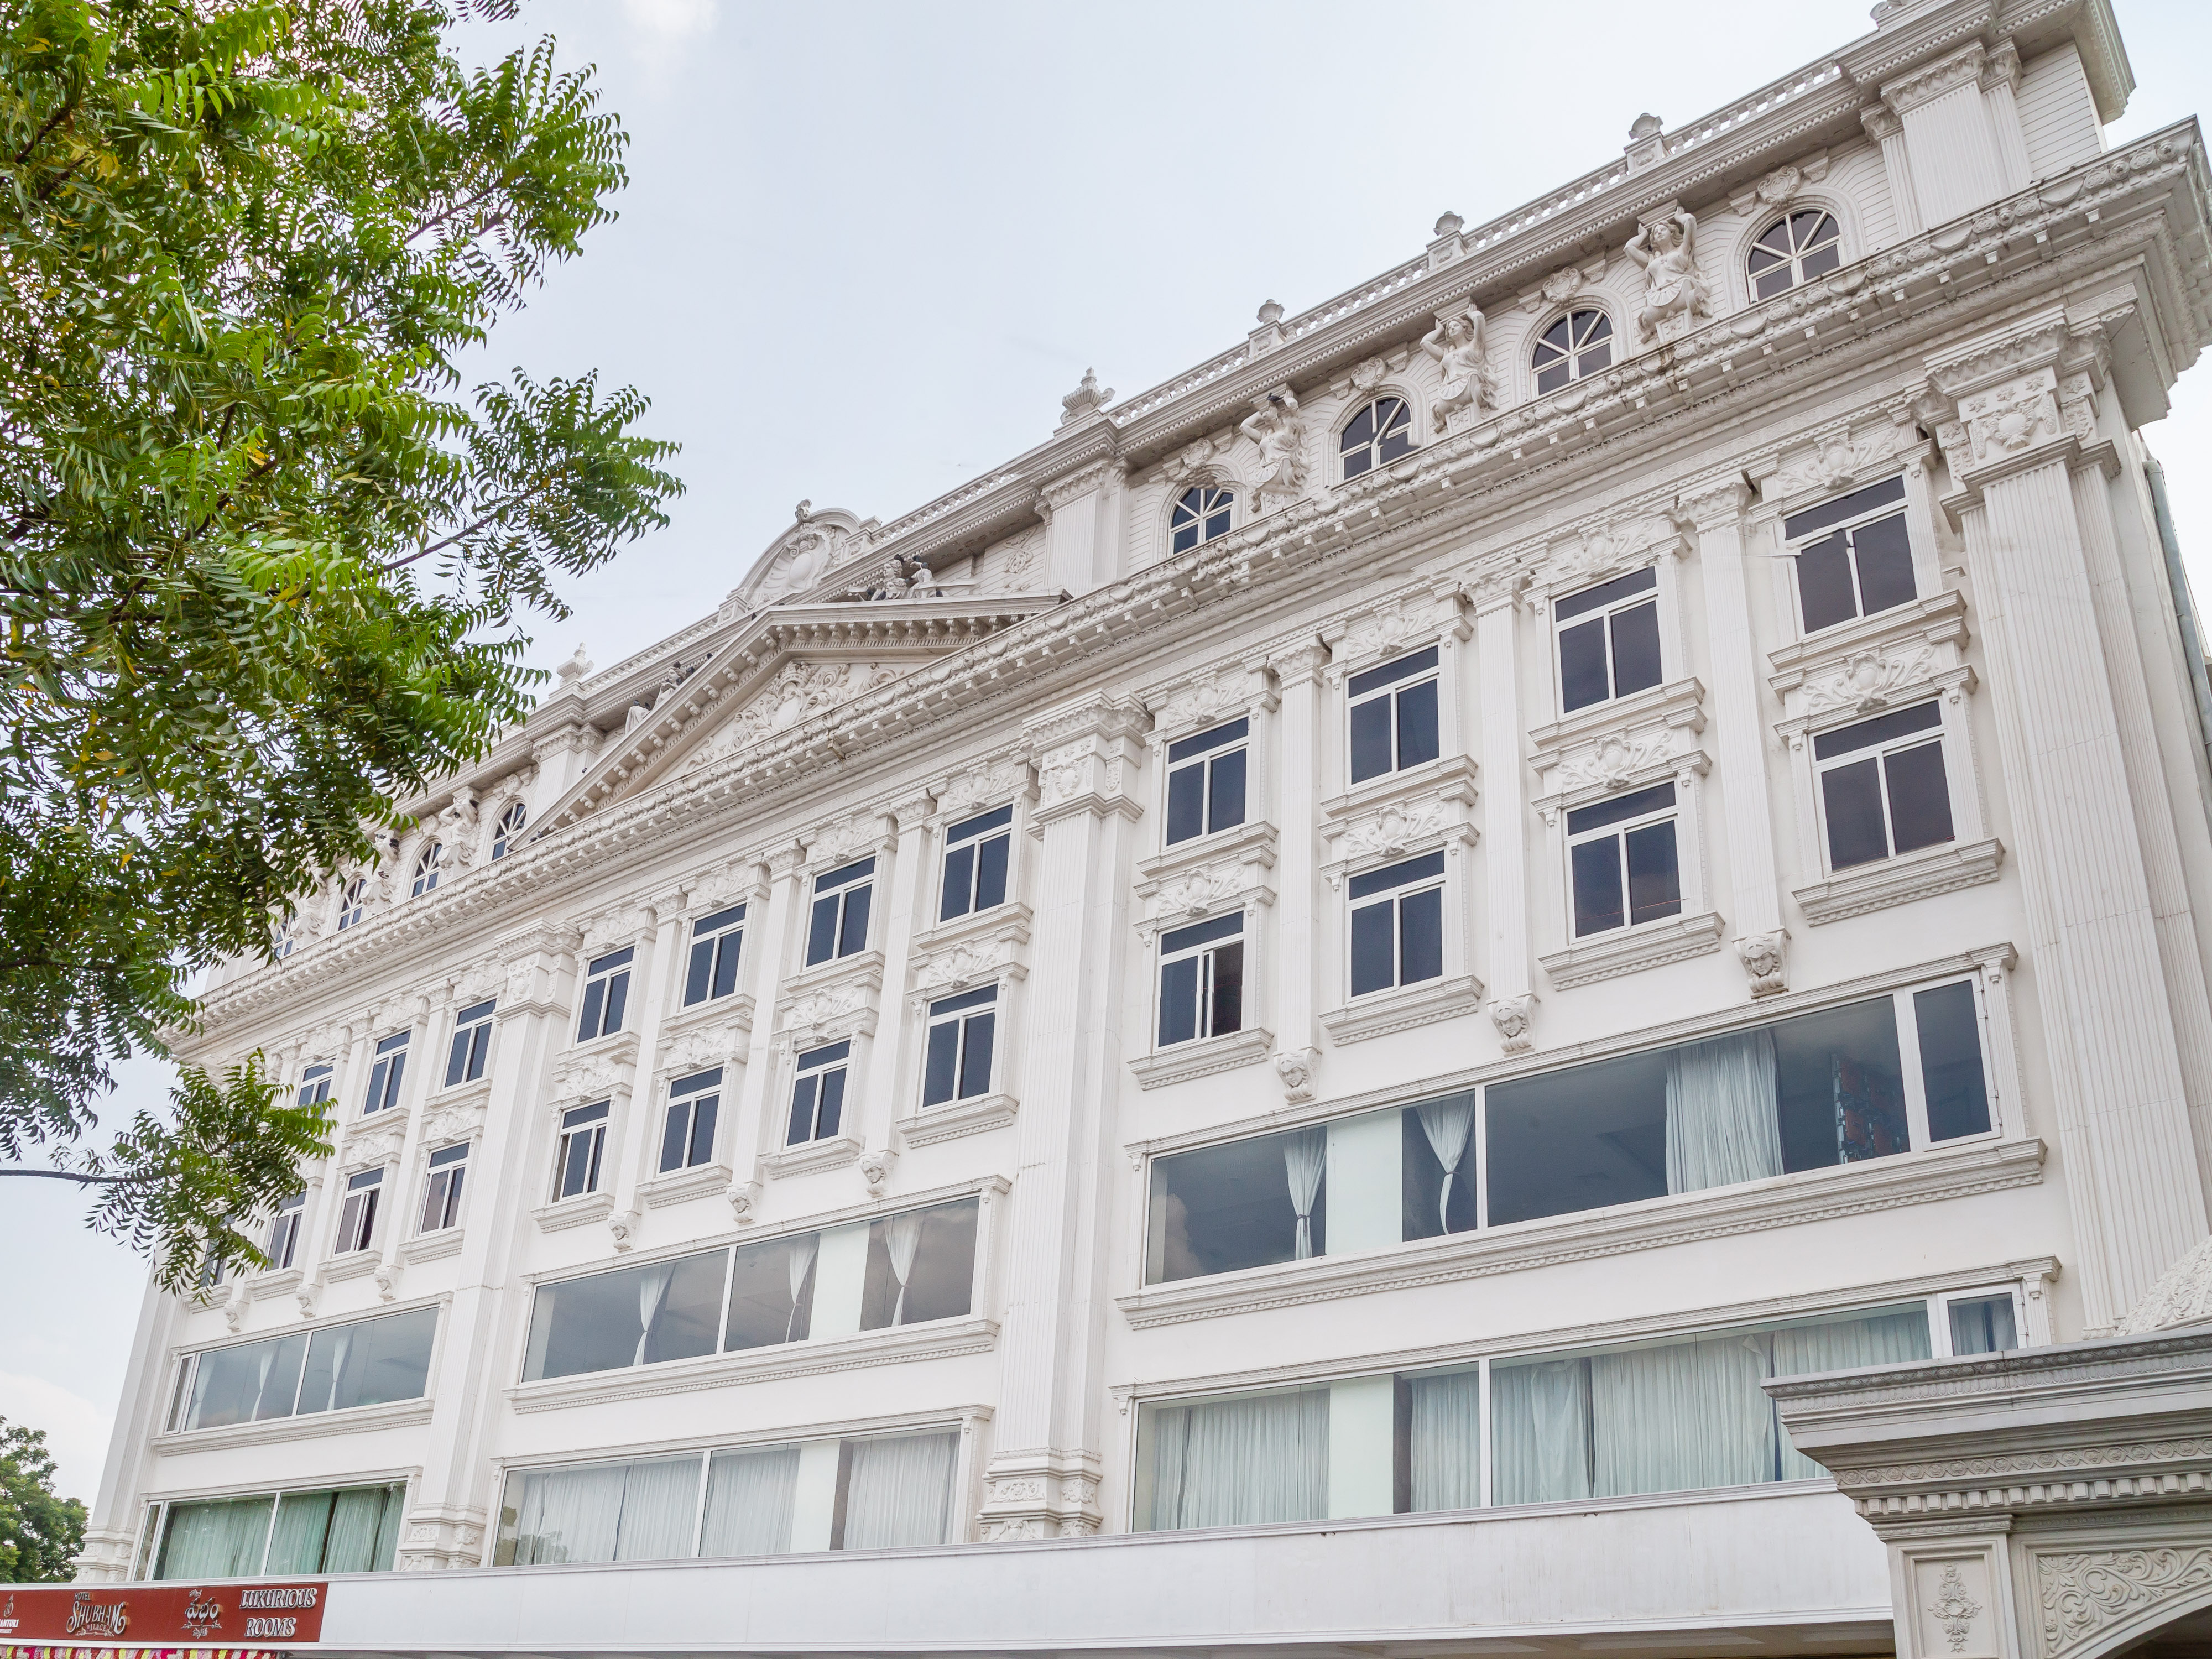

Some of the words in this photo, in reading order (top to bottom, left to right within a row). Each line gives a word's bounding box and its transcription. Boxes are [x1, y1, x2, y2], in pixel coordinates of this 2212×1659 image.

[74, 1592, 91, 1600] HOTEL
[239, 1588, 317, 1609] LUXURIOUS
[66, 1601, 126, 1634] SHUBHAM
[86, 1623, 107, 1632] PALACE
[244, 1617, 296, 1637] ROOMS
